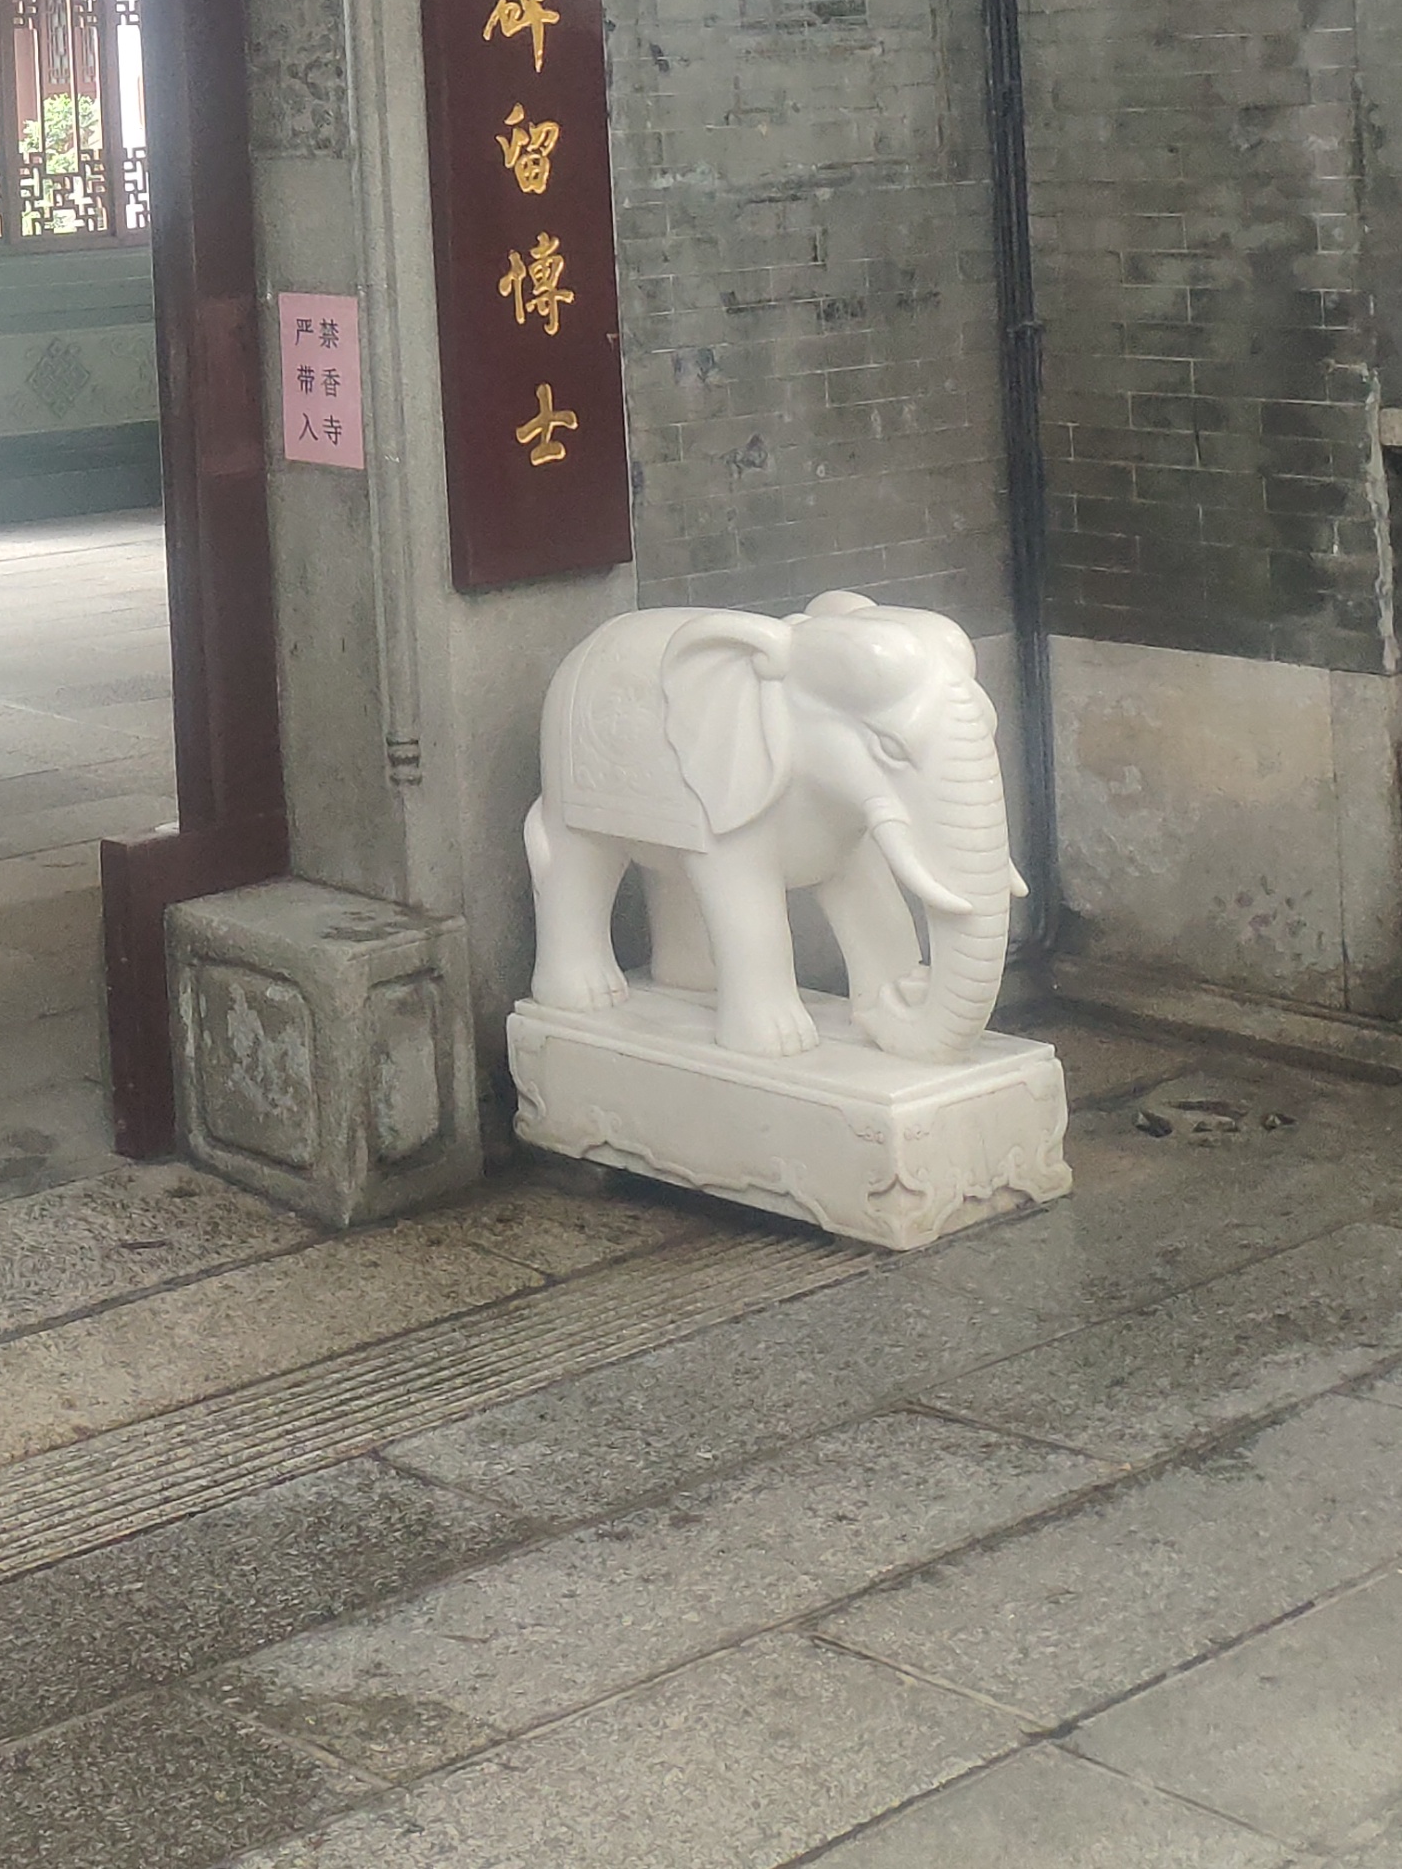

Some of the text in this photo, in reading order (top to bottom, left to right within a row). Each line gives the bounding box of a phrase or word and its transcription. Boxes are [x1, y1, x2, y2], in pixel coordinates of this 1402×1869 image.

[295, 318, 340, 349] 严禁
[296, 364, 341, 397] 带香
[298, 412, 343, 446] 入寺
